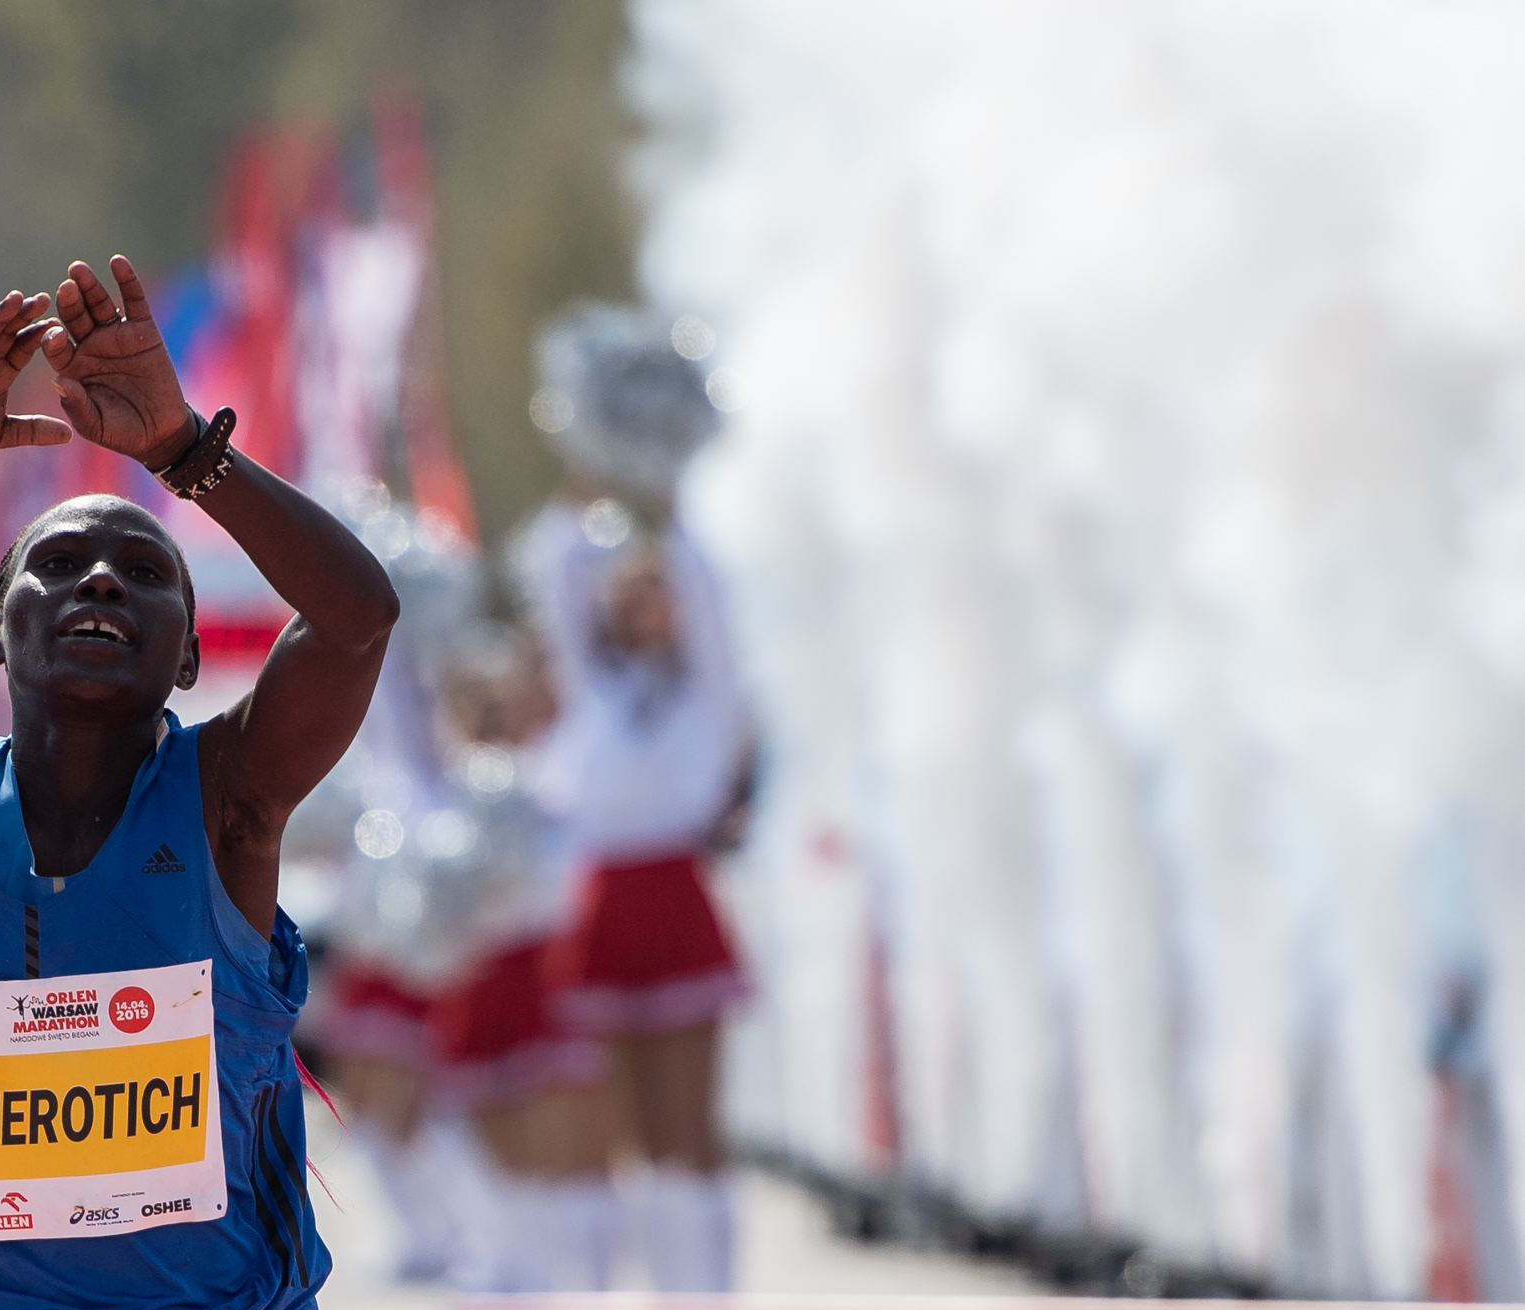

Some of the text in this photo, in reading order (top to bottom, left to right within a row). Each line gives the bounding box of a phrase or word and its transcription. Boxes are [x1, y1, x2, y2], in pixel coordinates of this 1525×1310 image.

[141, 863, 186, 874] adidas
[46, 989, 97, 1005] ORLEN
[31, 1003, 99, 1020] WARSAW
[115, 1000, 149, 1011] 14.04.
[116, 1009, 150, 1022] 2019
[13, 1015, 100, 1034] MARATHON
[141, 1198, 192, 1217] OSHEE
